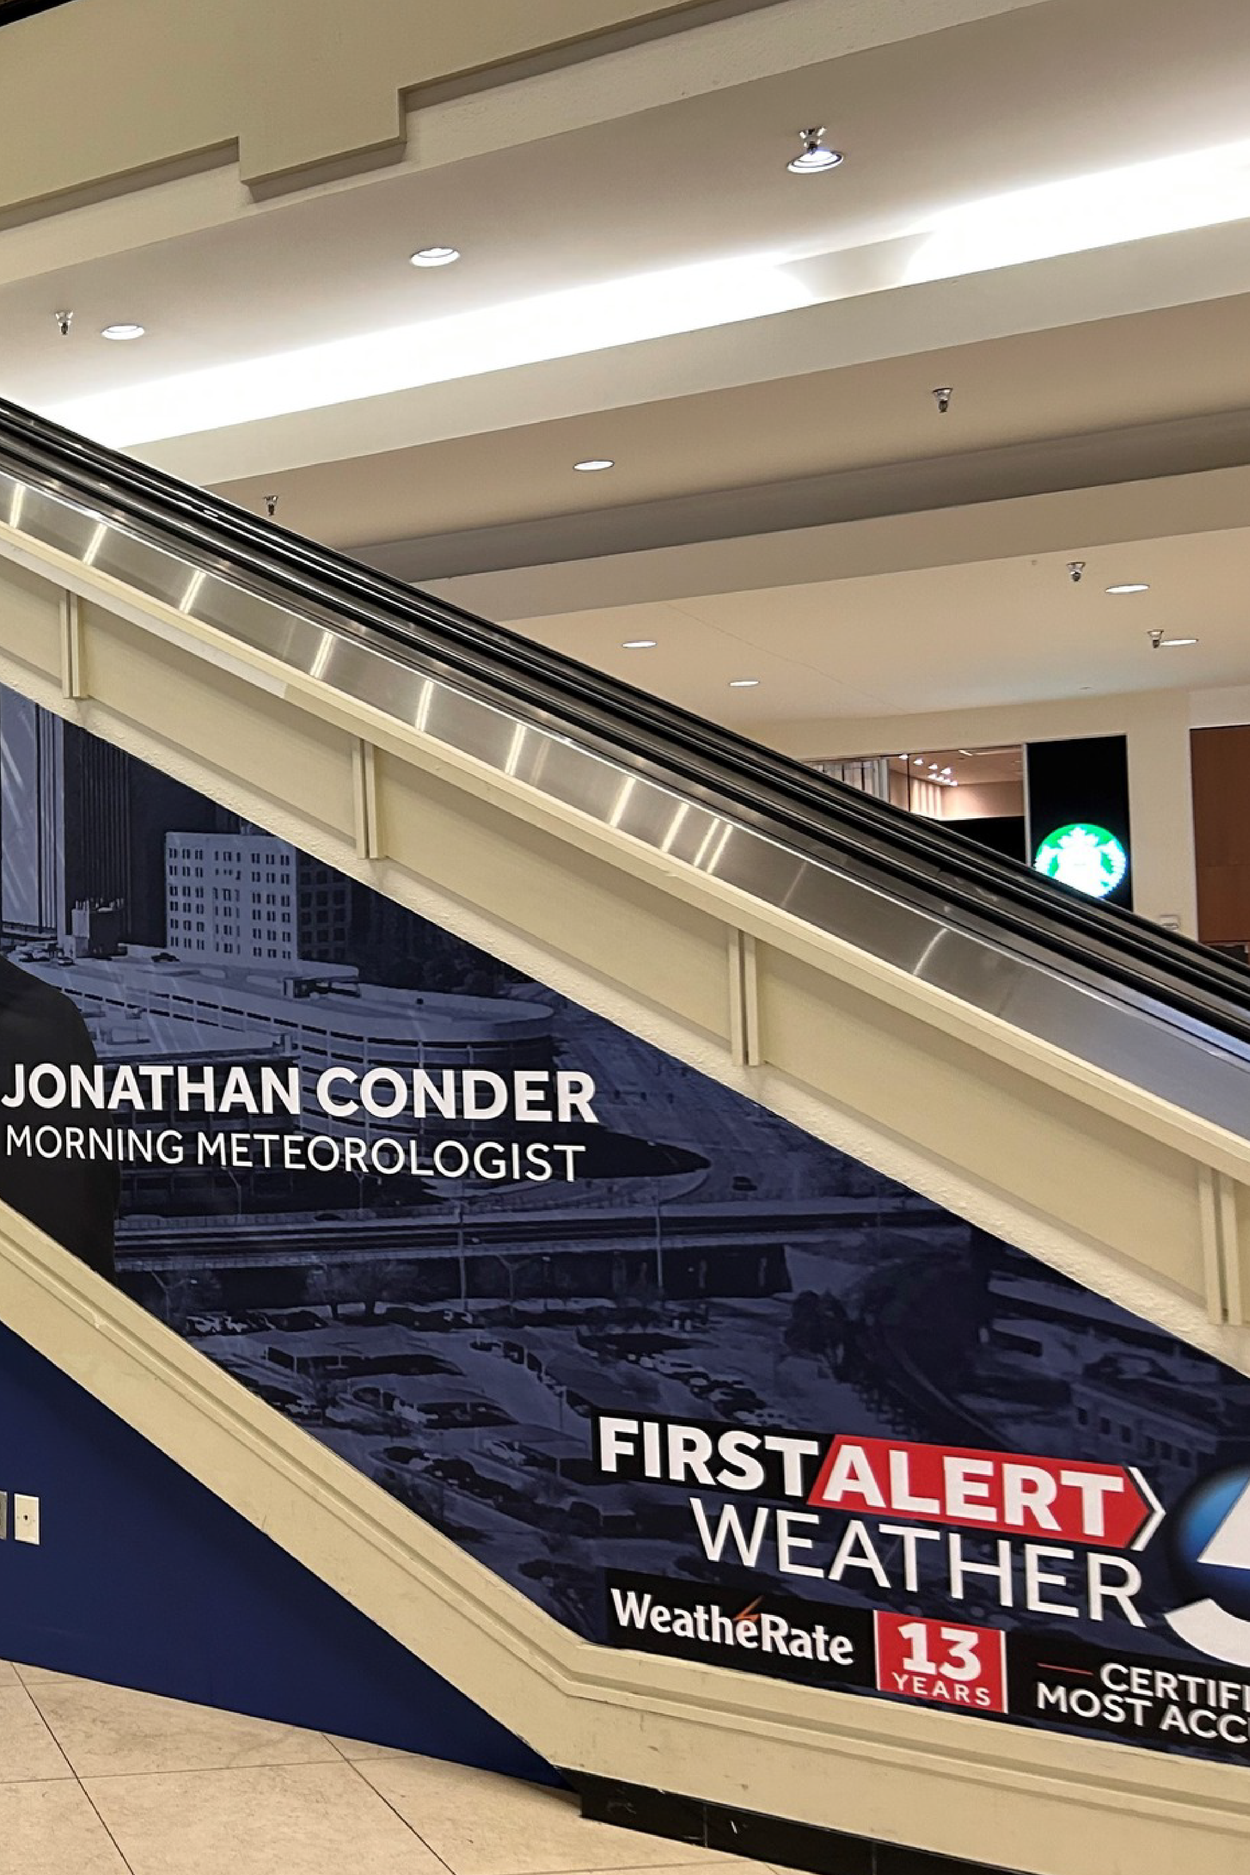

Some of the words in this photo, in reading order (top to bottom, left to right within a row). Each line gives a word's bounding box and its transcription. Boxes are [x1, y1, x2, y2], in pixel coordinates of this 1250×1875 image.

[1, 1063, 299, 1115] JONATHAN
[316, 1067, 599, 1123] CONDER
[5, 1124, 184, 1165] MORNING
[197, 1131, 586, 1183] METEOROLOGIST
[690, 1497, 1147, 1628] WEATHER
[898, 1621, 983, 1681] 13
[893, 1671, 991, 1706] YEARS
[1036, 1681, 1152, 1726] MOST
[1159, 1704, 1250, 1744] ACC
